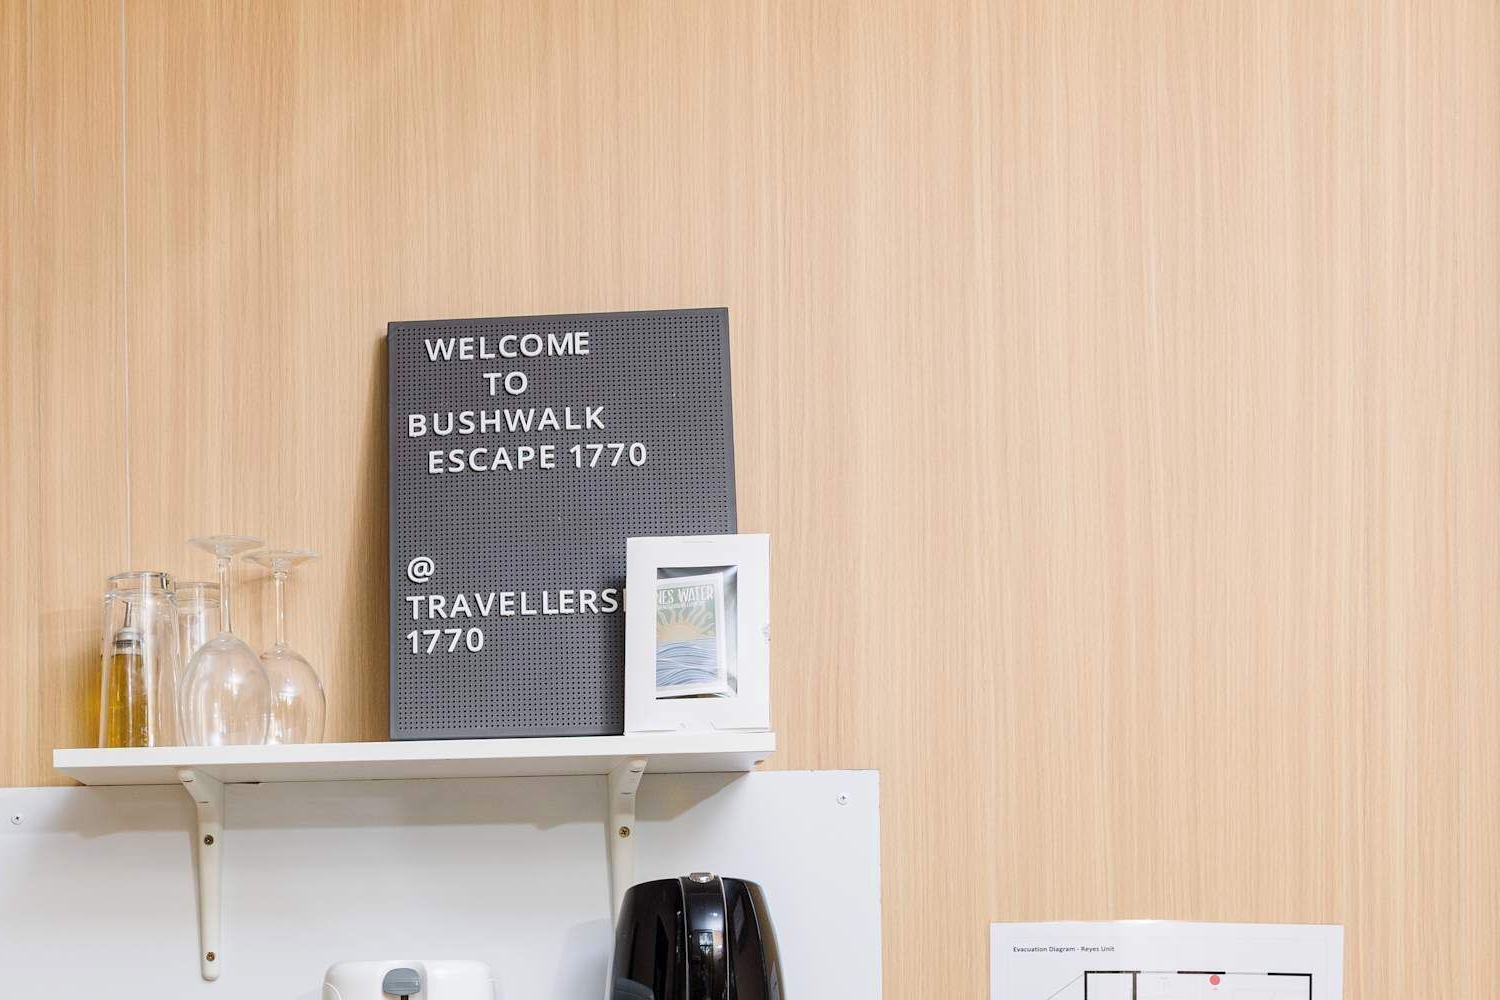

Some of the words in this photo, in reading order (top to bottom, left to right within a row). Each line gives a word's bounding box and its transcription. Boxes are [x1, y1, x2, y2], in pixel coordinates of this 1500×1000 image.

[425, 331, 590, 361] WELCOME
[483, 371, 528, 396] TO
[407, 406, 605, 438] BUSHWALK
[428, 445, 556, 474] ESCAPE
[569, 442, 647, 468] 1770
[407, 556, 435, 583] @
[406, 588, 627, 620] TRAVELLERS
[406, 627, 484, 655] 1770
[1013, 945, 1048, 953] Evacuation
[1049, 946, 1076, 954] Diagram
